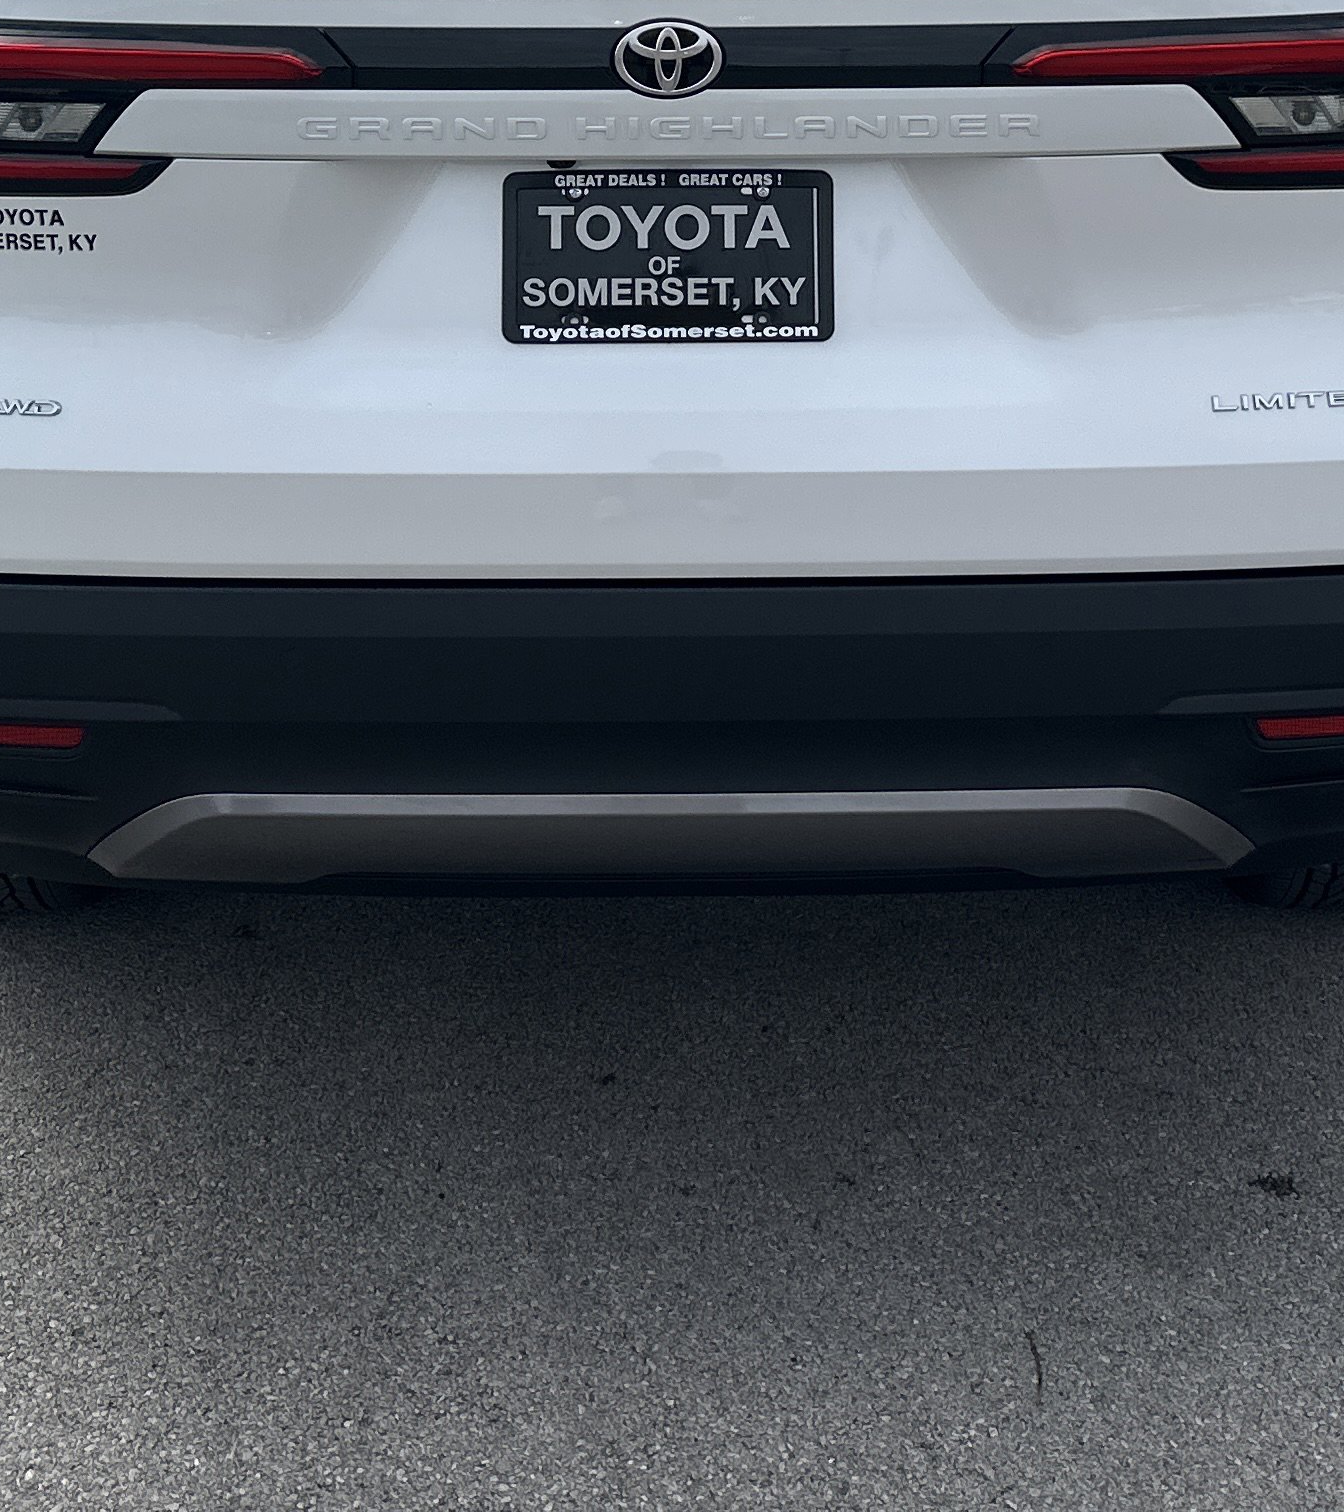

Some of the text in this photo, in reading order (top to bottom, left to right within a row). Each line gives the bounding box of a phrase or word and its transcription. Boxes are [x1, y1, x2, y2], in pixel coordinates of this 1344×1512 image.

[296, 113, 1041, 140] GRAND HIGHLANDER
[555, 174, 606, 188] GREAT
[679, 173, 729, 186] GREAT
[538, 204, 791, 251] TOYOTA
[69, 234, 97, 252] KY
[648, 256, 681, 275] OF
[522, 277, 807, 311] SOMERSET, KY
[519, 324, 819, 341] ToyotaofSomerset.com
